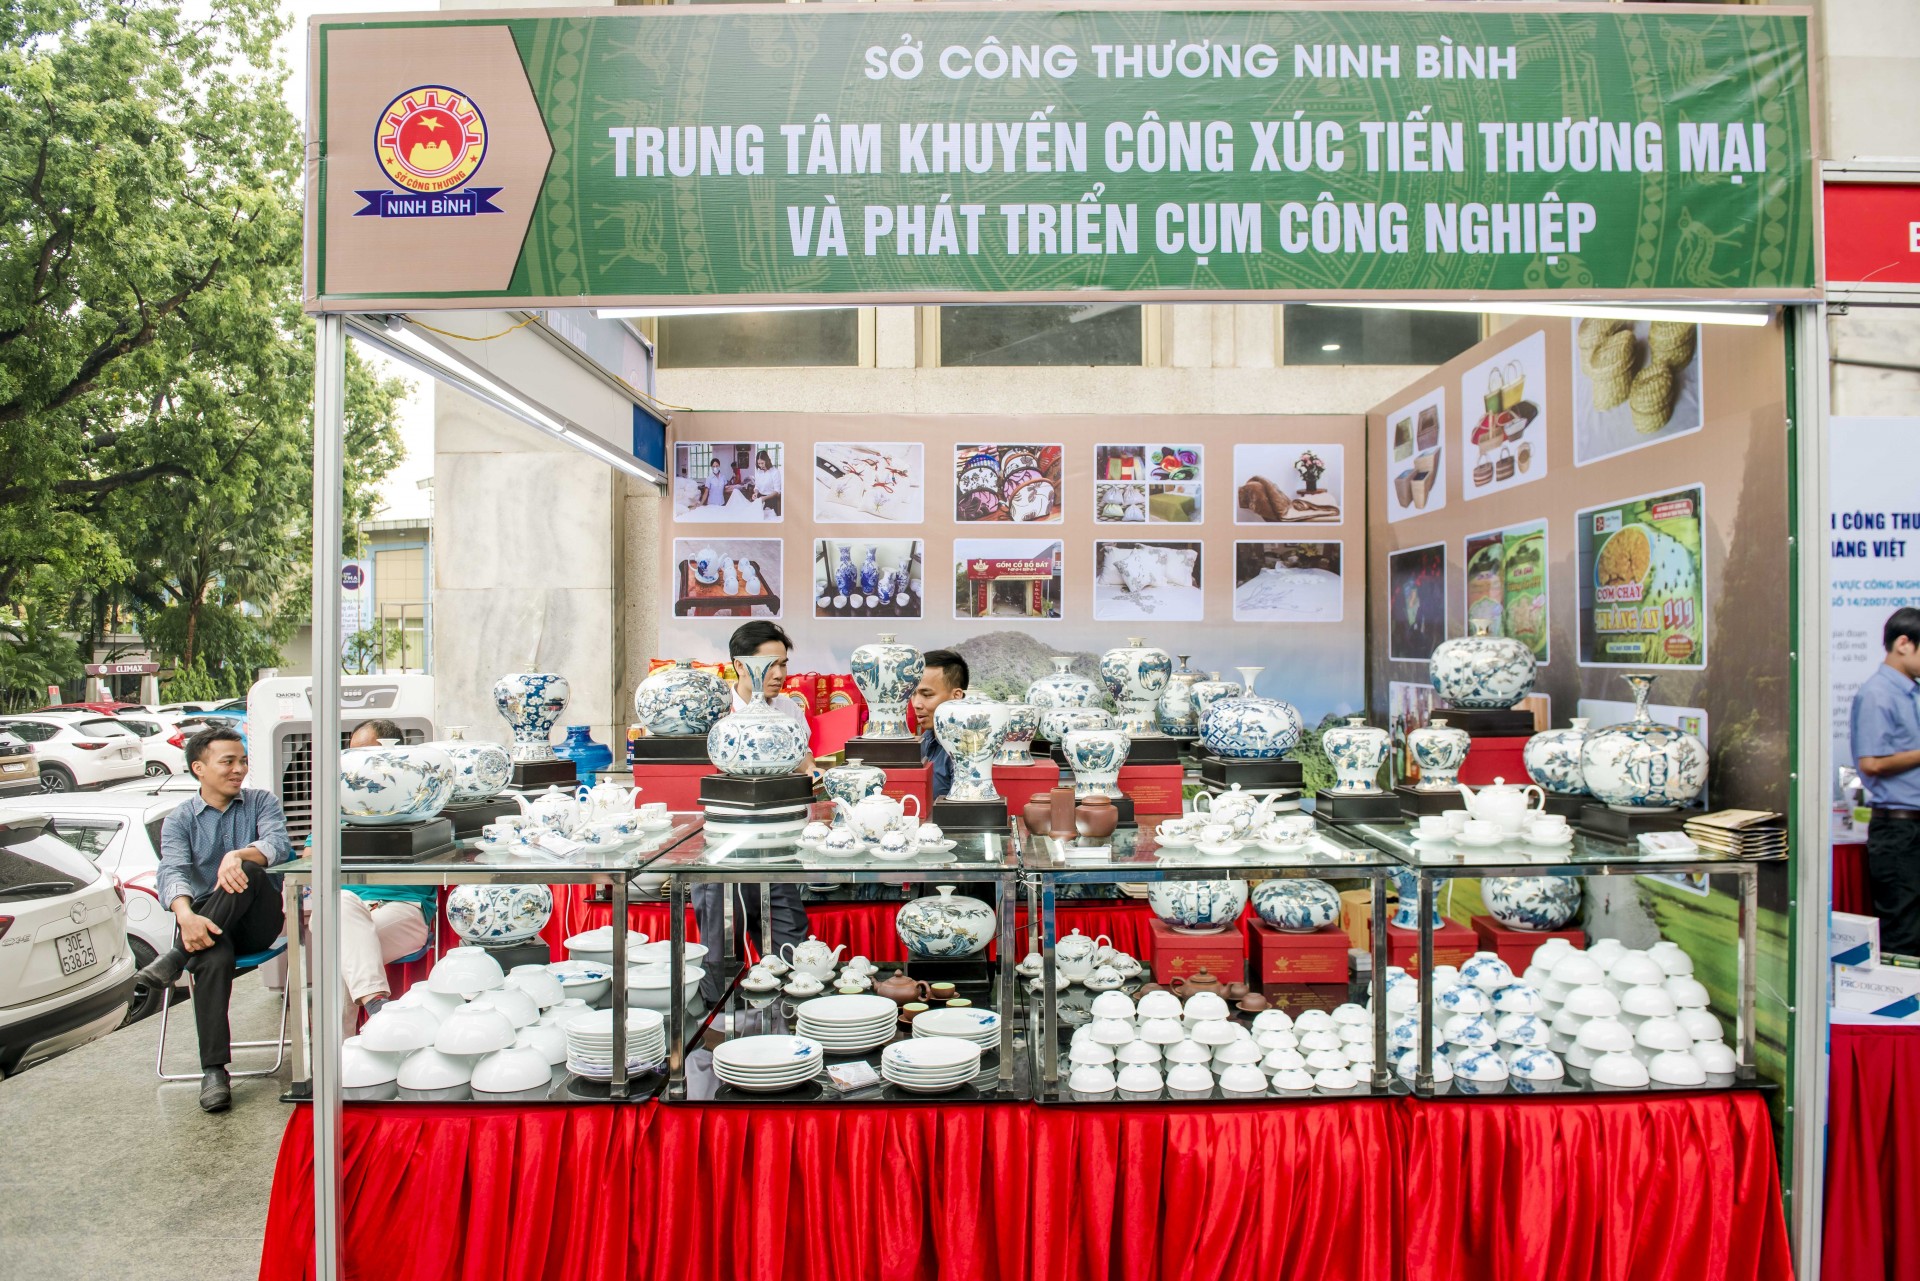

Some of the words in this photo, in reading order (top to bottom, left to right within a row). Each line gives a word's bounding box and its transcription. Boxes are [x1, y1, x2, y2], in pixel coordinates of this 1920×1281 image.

[866, 34, 924, 80] SỞ
[940, 37, 1078, 80] CÔNG
[1093, 40, 1279, 79] THƯƠNG
[1296, 45, 1400, 79] NINH
[1417, 37, 1518, 80] BÌNH
[610, 126, 764, 177] TRUNG
[782, 114, 882, 175] TÂM
[901, 106, 1087, 174] KHUYẾN
[1105, 111, 1235, 172] CÔNG
[1252, 111, 1345, 173] XÚC
[1361, 106, 1464, 172] TIẾN
[1480, 117, 1663, 173] THƯƠNG
[1680, 123, 1767, 184] MẠI
[394, 171, 407, 183] SỞ
[406, 178, 430, 191] CÔNG
[431, 170, 467, 190] THƯƠNG
[387, 200, 426, 215] NINH
[431, 195, 471, 214] BÌNH
[787, 195, 849, 257] VÀ
[866, 195, 986, 256] PHÁT
[1002, 183, 1138, 256] TRIỂN
[1156, 203, 1263, 266] CỤM
[1281, 193, 1408, 254] CÔNG
[1426, 192, 1597, 265] NGHIỆP
[1842, 509, 1885, 530] CÔNG
[1832, 537, 1867, 558] ÀNG
[1873, 537, 1906, 562] VIỆT
[1035, 560, 1049, 568] BÁT
[1863, 578, 1894, 590] CÔNG
[1640, 607, 1660, 629] AN
[1664, 597, 1695, 630] 999
[116, 664, 143, 673] CLIMAX
[65, 933, 85, 953] 30E
[62, 947, 95, 973] 538.25
[1840, 979, 1904, 994] PRODIGIOSIN
